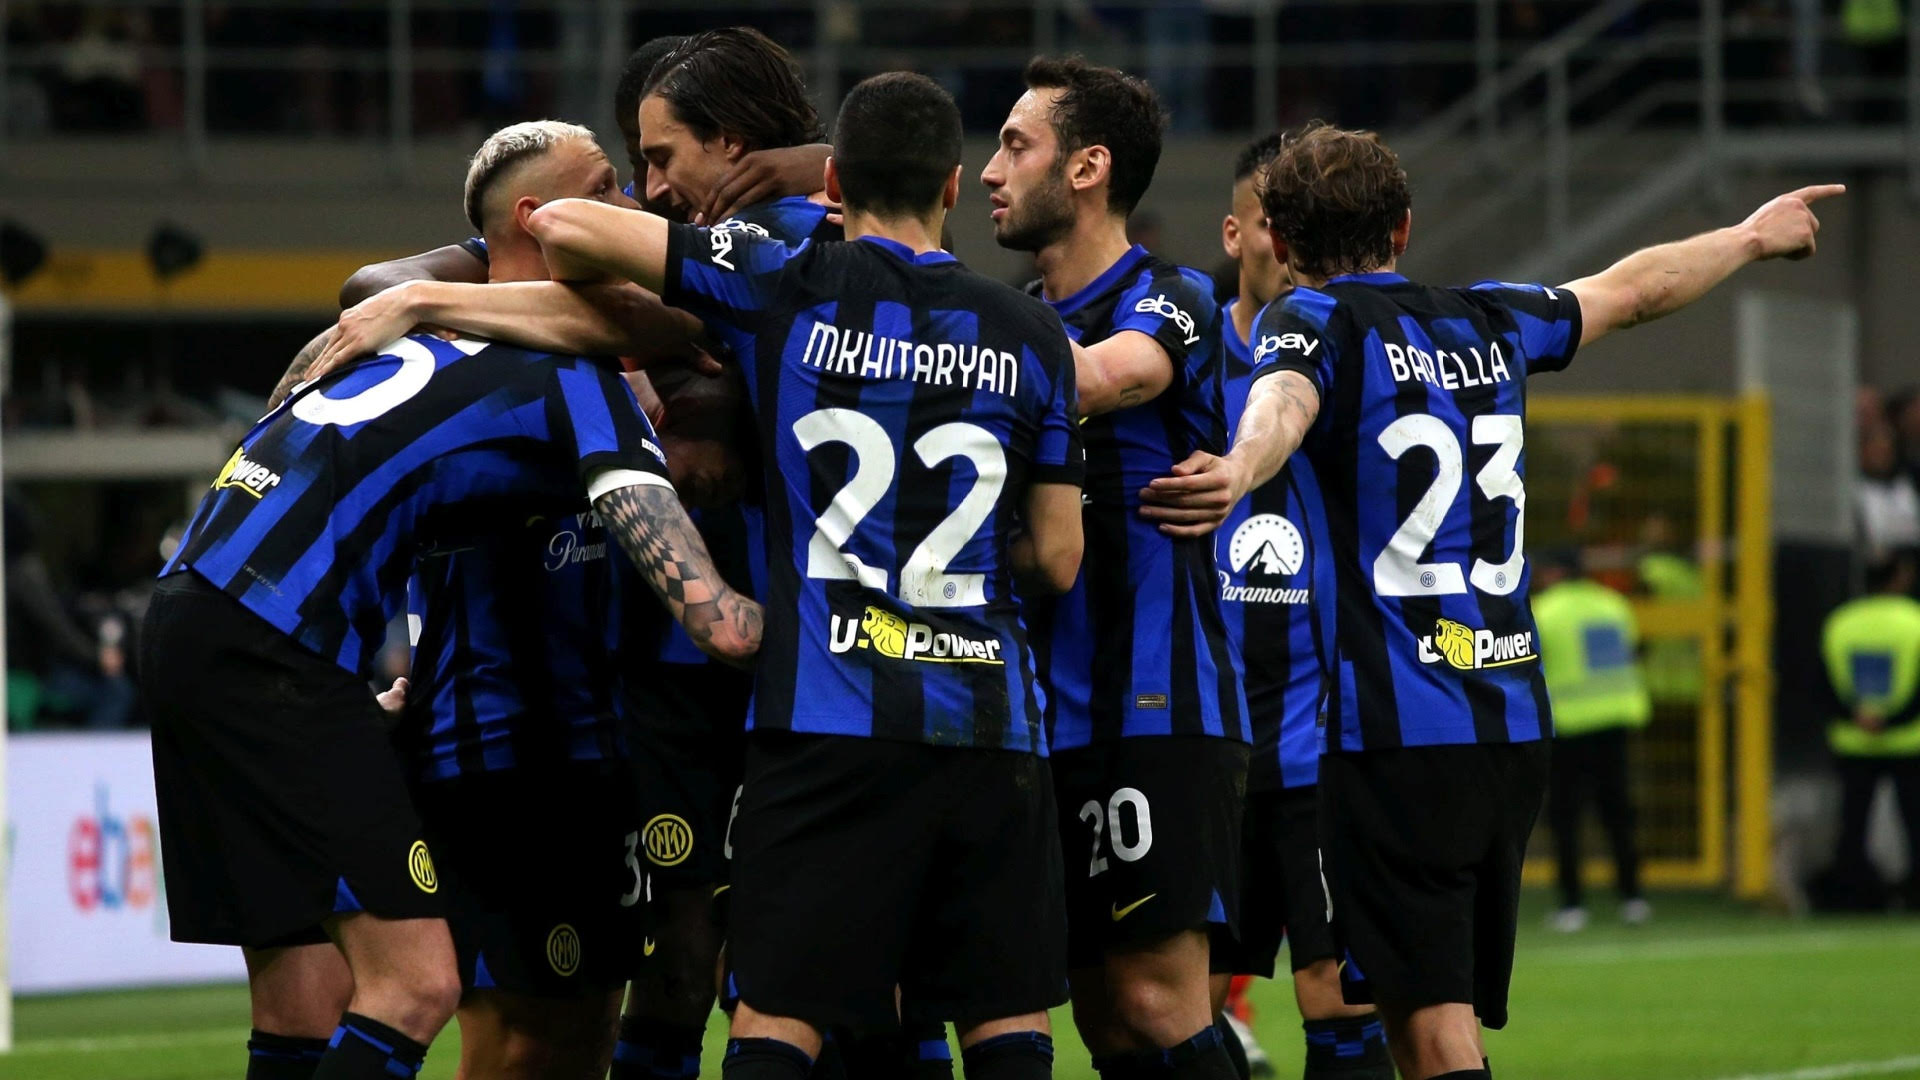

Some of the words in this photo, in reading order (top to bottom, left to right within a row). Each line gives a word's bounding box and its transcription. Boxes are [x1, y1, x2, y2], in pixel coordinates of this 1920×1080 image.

[1135, 294, 1200, 346] ebay
[1254, 333, 1319, 365] ebay
[802, 321, 1018, 397] MKHITARYAN
[1384, 341, 1511, 391] BARELLA
[792, 407, 1008, 607] 22
[1373, 413, 1526, 597] 23
[1218, 569, 1309, 605] Paramoun
[1079, 787, 1153, 877] 20
